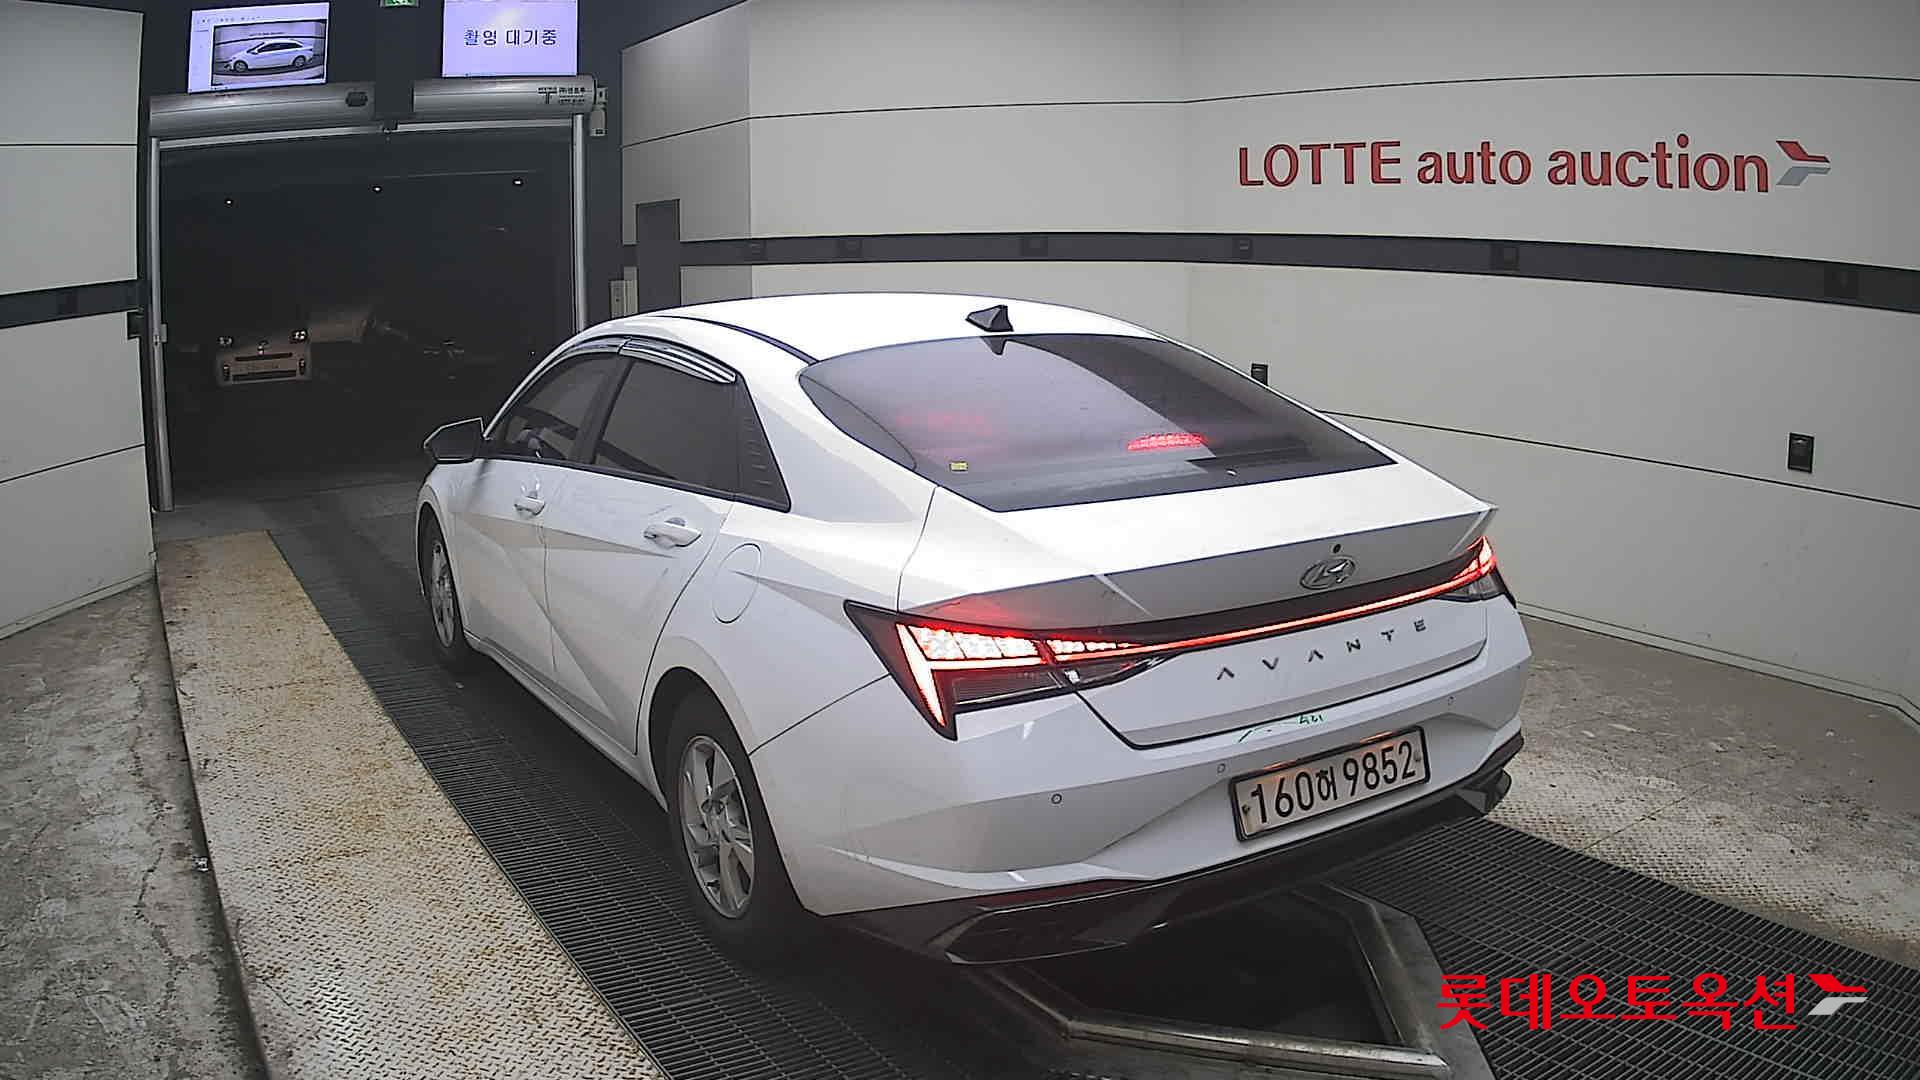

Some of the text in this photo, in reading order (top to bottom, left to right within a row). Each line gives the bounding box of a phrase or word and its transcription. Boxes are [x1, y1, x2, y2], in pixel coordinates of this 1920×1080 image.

[506, 29, 557, 46] 대기중
[1238, 133, 1770, 193] LOTTE auto auction
[1216, 619, 1427, 681] AVANTE
